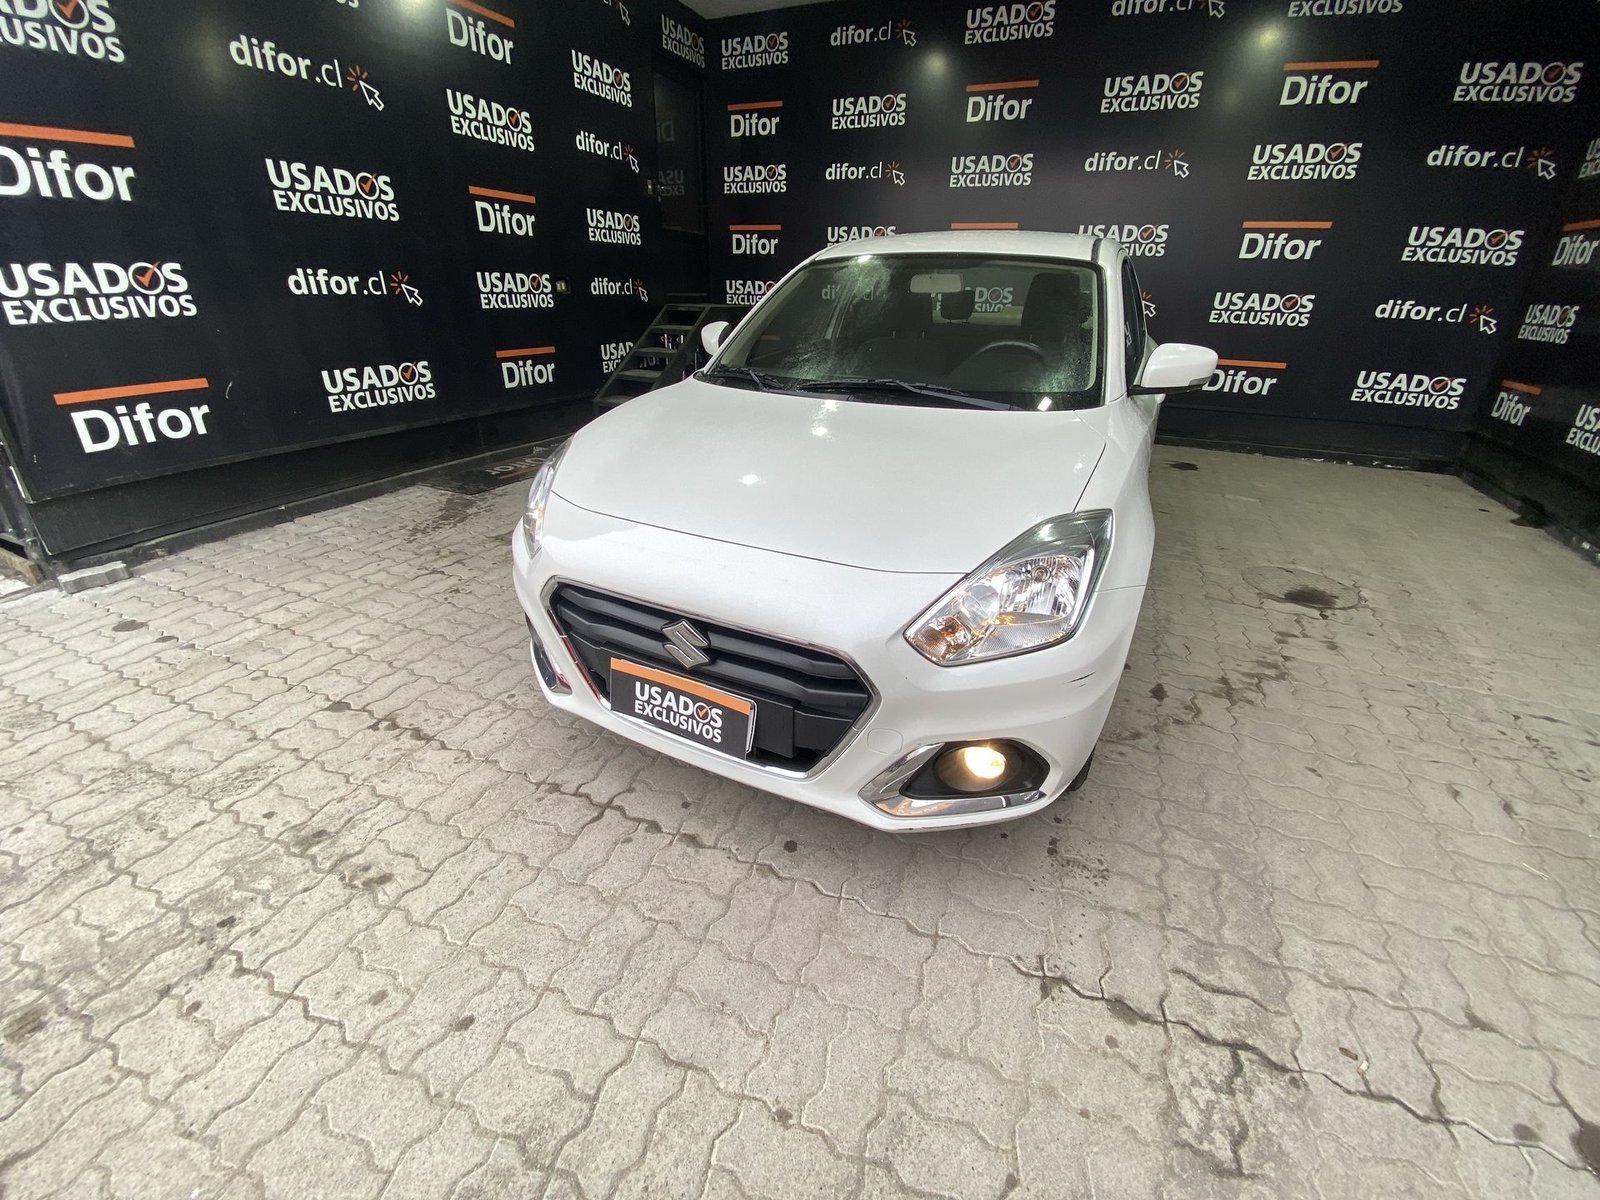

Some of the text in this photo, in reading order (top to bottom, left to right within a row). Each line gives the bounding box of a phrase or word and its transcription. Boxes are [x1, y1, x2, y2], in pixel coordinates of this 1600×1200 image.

[966, 2, 1056, 28] USADOS
[1287, 0, 1404, 18] EXCLUSIVOS
[0, 16, 125, 63] USIVOS
[446, 7, 514, 65] Difor
[661, 14, 705, 54] USADOS
[721, 31, 789, 56] USADOS
[830, 20, 892, 46] difor.cl
[964, 22, 1054, 45] EXCLUSIVOS
[229, 35, 343, 88] difor.cl
[662, 34, 706, 69] EXCLUSIVOS
[721, 50, 789, 70] EXCLUSIVOS
[571, 49, 631, 92] USADOS
[1460, 62, 1584, 86] USADOS
[573, 73, 633, 108] EXCLUSIVOS
[1102, 71, 1204, 97] USADOS
[1279, 75, 1368, 106] Difor
[1453, 85, 1576, 103] EXCLUSIVOS
[446, 89, 532, 133] USADOS
[832, 93, 906, 116] USADOS
[966, 95, 1032, 123] Difor
[1100, 93, 1200, 114] EXCLUSIVOS
[450, 115, 535, 152] EXCLUSIVOS
[730, 113, 780, 138] Difor
[831, 112, 906, 130] EXCLUSIVOS
[576, 130, 623, 161] difor.cl
[1252, 143, 1363, 164] USADOS
[1426, 145, 1525, 170] difor.cl
[723, 164, 787, 182] USADOS
[825, 162, 883, 181] difor.cl
[951, 153, 1034, 174] USADOS
[1084, 150, 1162, 172] difor.cl
[1247, 164, 1357, 181] EXCLUSIVOS
[0, 146, 136, 202] Difor
[265, 158, 395, 202] USADOS
[949, 173, 1032, 188] EXCLUSIVOS
[724, 181, 787, 194] EXCLUSIVOS
[273, 190, 400, 222] EXCLUSIVOS
[475, 201, 536, 237] Difor
[586, 208, 641, 232] USADOS
[588, 228, 642, 246] EXCLUSIVOS
[732, 234, 779, 255] Difor
[1239, 233, 1321, 260] Difor
[1407, 226, 1524, 251] USADOS
[1400, 248, 1518, 266] EXCLUSIVOS
[1551, 234, 1600, 266] Difor
[0, 262, 189, 298] USADOS
[287, 268, 388, 296] difor.cl
[476, 272, 551, 294] USADOS
[590, 277, 633, 296] difor.cl
[2, 294, 198, 326] EXCLUSIVOS
[480, 293, 554, 309] EXCLUSIVOS
[1213, 292, 1315, 315] USADOS
[1374, 299, 1467, 324] difor.cl
[1209, 310, 1310, 327] EXCLUSIVOS
[1525, 304, 1580, 328] USADOS
[1518, 324, 1571, 345] EXCLUSIVOS
[321, 360, 433, 395] USADOS
[501, 360, 556, 389] Difor
[1201, 368, 1278, 396] Difor
[1357, 370, 1467, 395] USADOS
[328, 382, 437, 413] EXCLUSIVOS
[1350, 388, 1461, 411] EXCLUSIVOS
[1490, 391, 1532, 427] Difor
[70, 401, 211, 454] Difor
[634, 681, 724, 728] USADOS
[634, 699, 723, 744] EXCLUSIVOS
